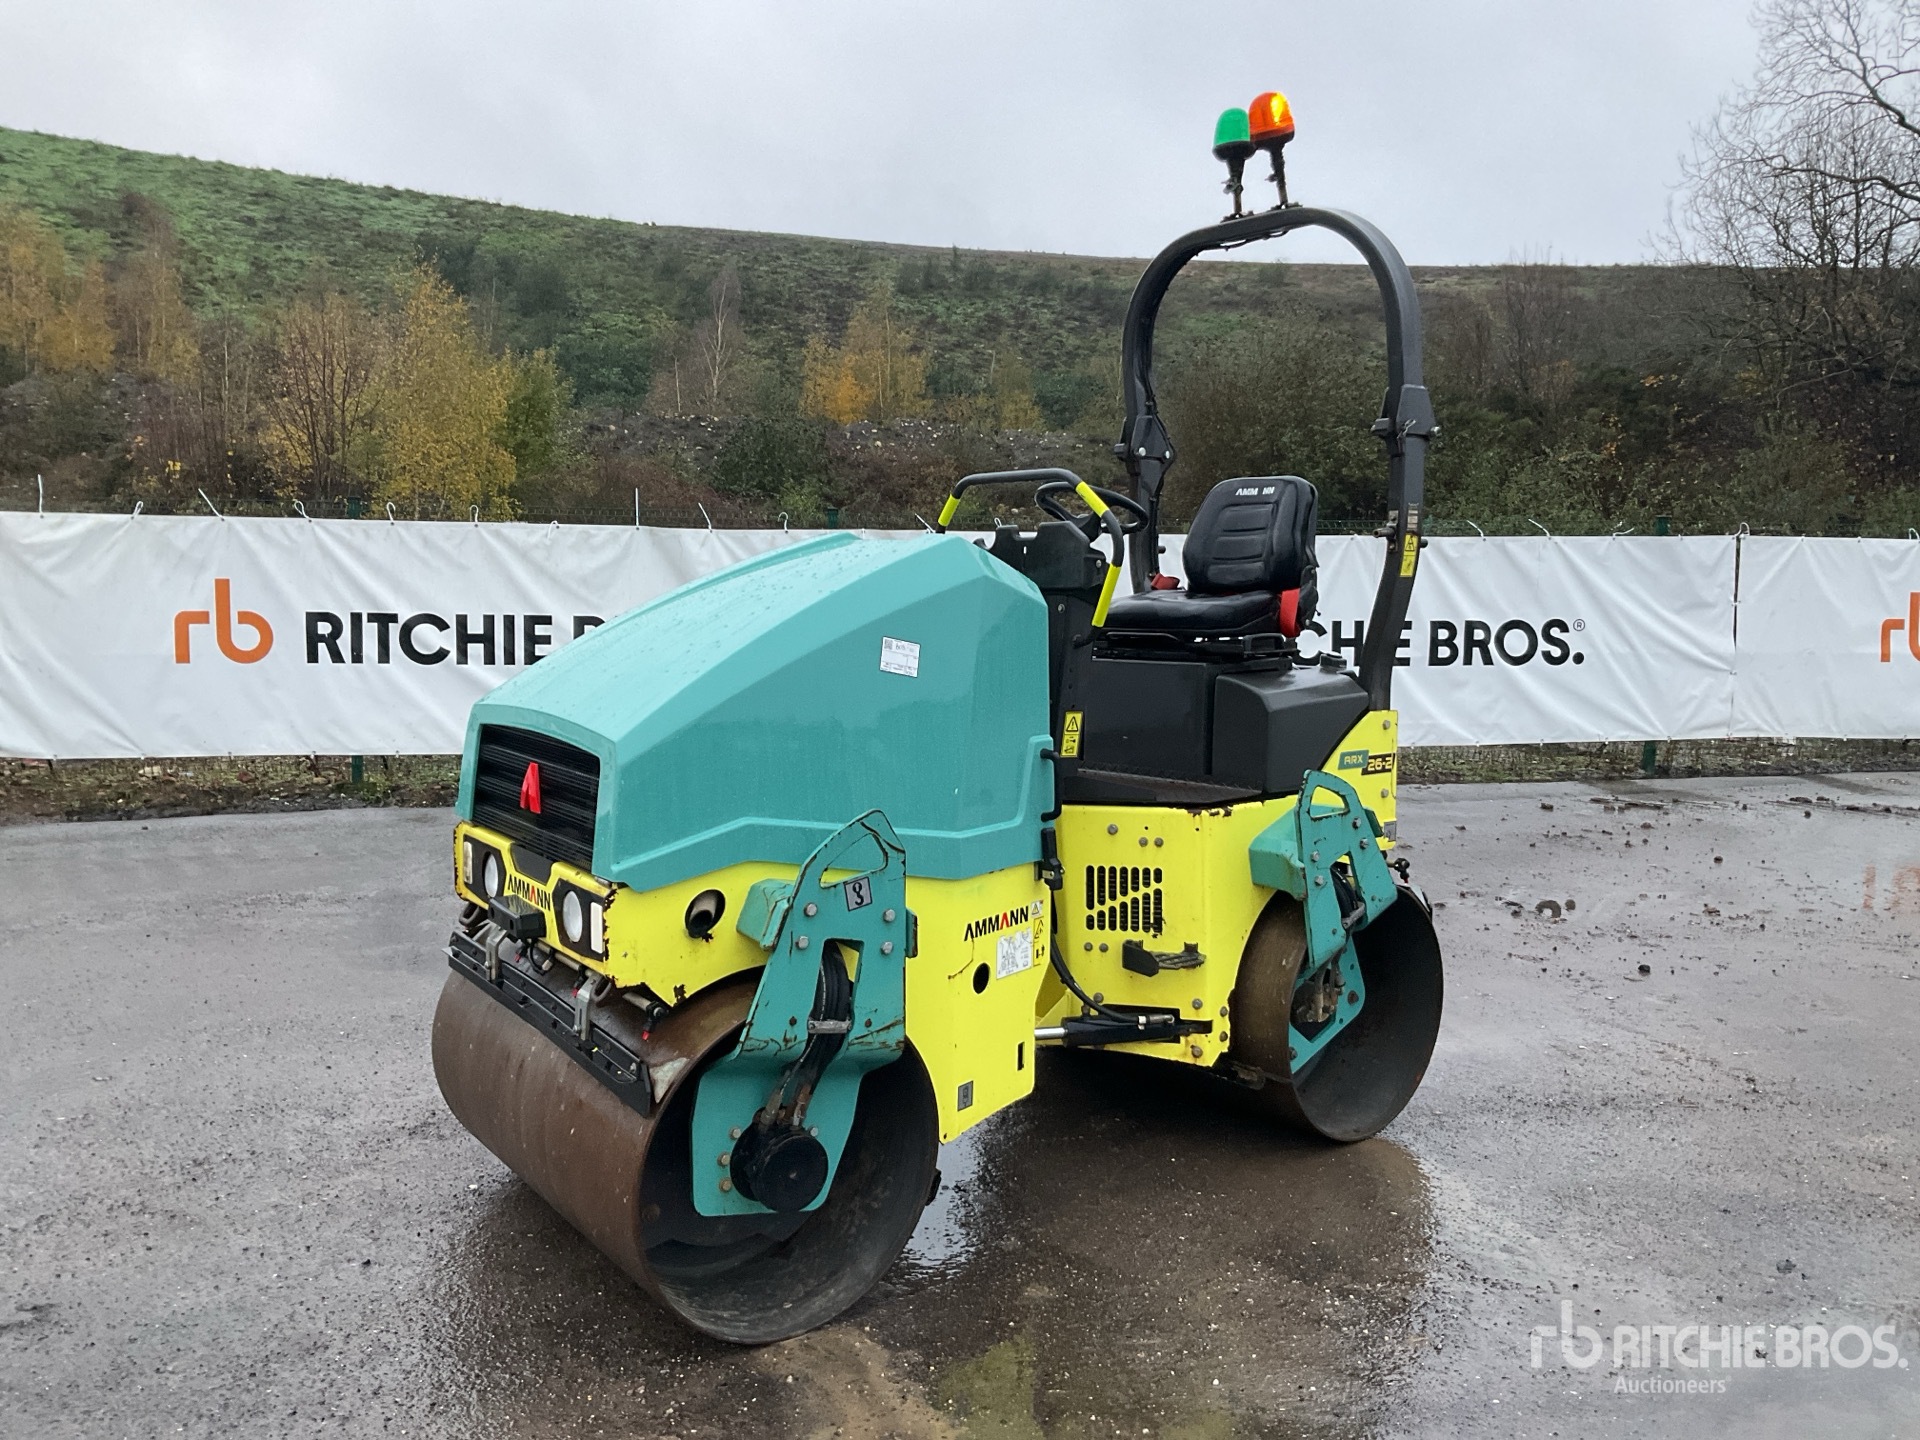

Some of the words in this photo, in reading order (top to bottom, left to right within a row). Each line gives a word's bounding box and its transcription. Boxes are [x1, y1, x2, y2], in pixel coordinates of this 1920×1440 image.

[306, 612, 552, 665] RITCHIE
[1344, 755, 1363, 765] ARX
[507, 876, 551, 911] AMMANN
[964, 906, 1029, 942] AMMANN
